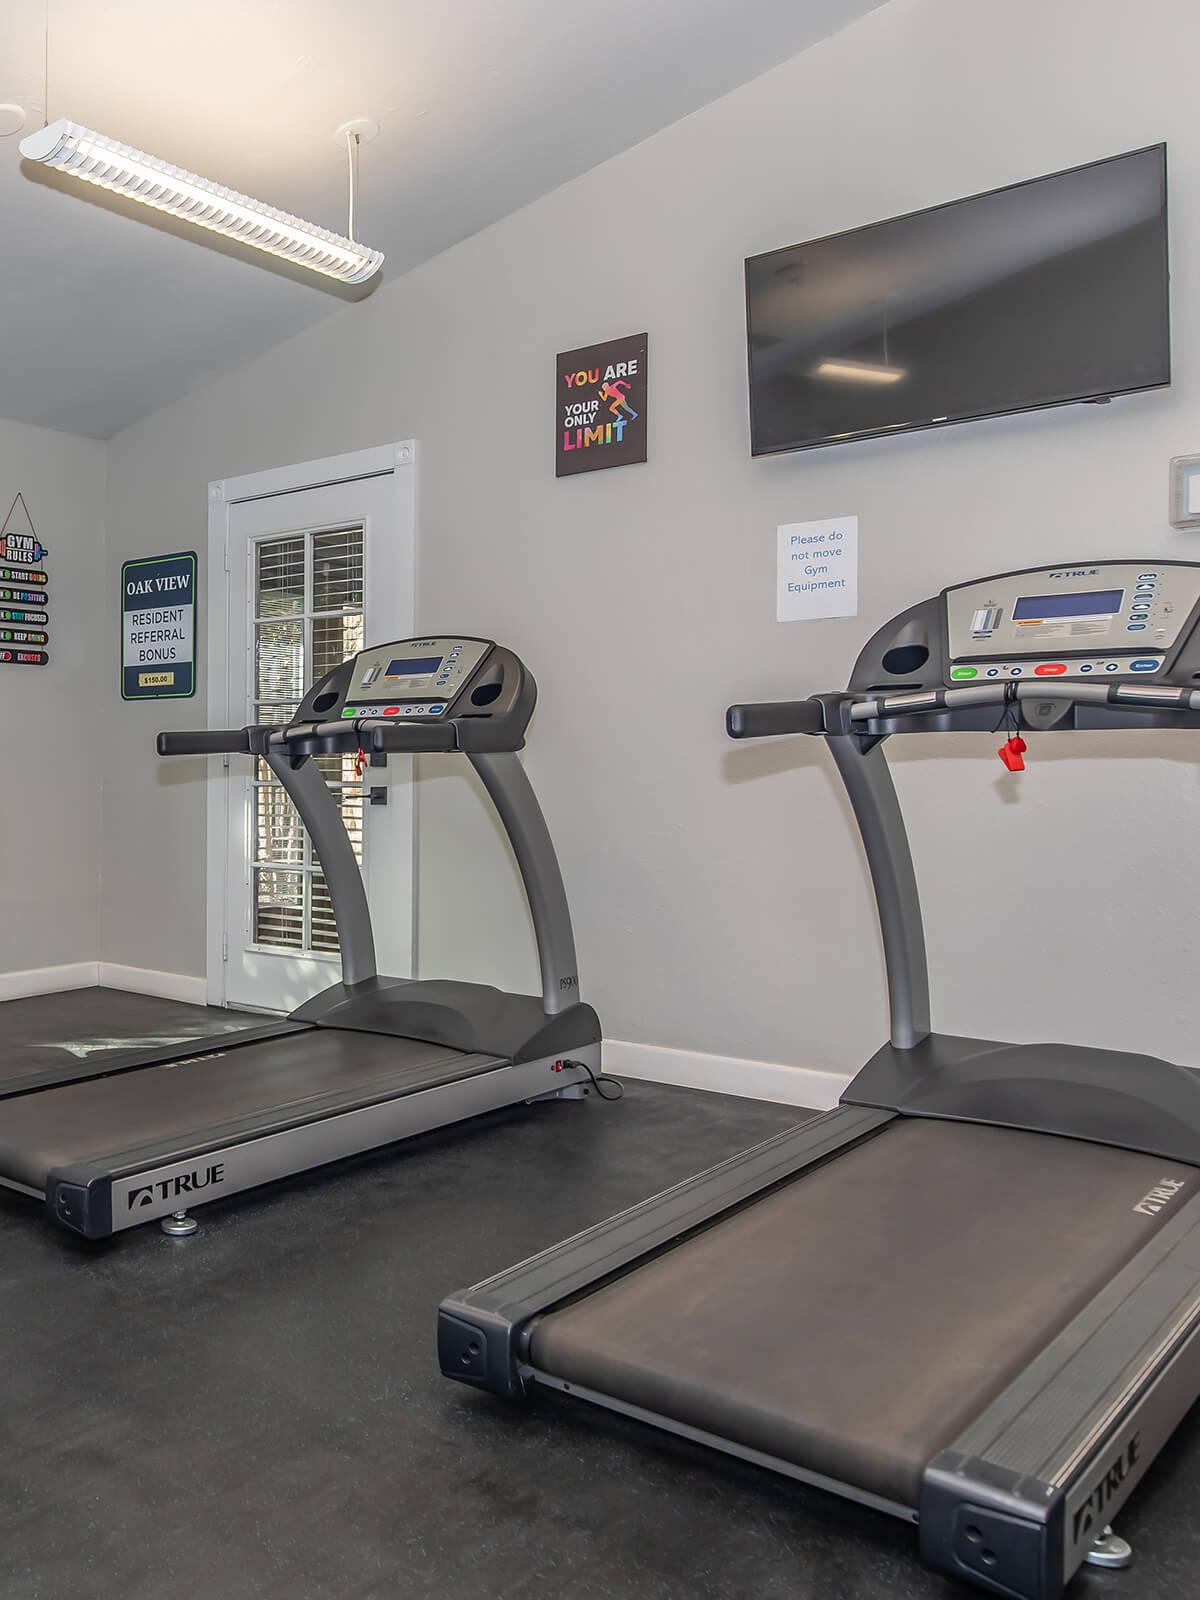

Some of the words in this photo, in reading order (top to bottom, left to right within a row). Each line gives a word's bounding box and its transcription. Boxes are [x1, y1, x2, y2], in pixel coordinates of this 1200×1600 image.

[564, 367, 599, 388] YOU
[603, 359, 638, 381] ARE
[564, 400, 599, 416] YOUR
[564, 412, 597, 428] ONLY
[563, 420, 628, 451] LIMIT
[7, 535, 34, 550] GYM
[790, 535, 825, 545] Please
[828, 531, 844, 541] do
[6, 550, 33, 562] RULES
[791, 551, 809, 561] not
[812, 548, 842, 559] move
[804, 565, 828, 577] Gym
[1064, 569, 1099, 577] TRUE
[127, 579, 153, 596] OAK
[155, 574, 191, 592] VIEW
[788, 579, 846, 593] Equipment
[132, 609, 184, 626] RESIDENT
[130, 628, 185, 644] REFERRAL
[139, 647, 177, 662] BONUS
[143, 675, 168, 684] $150.00
[155, 1163, 225, 1200] TRUE
[1141, 1178, 1185, 1204] TRUE
[1093, 1430, 1141, 1513] TRUE
